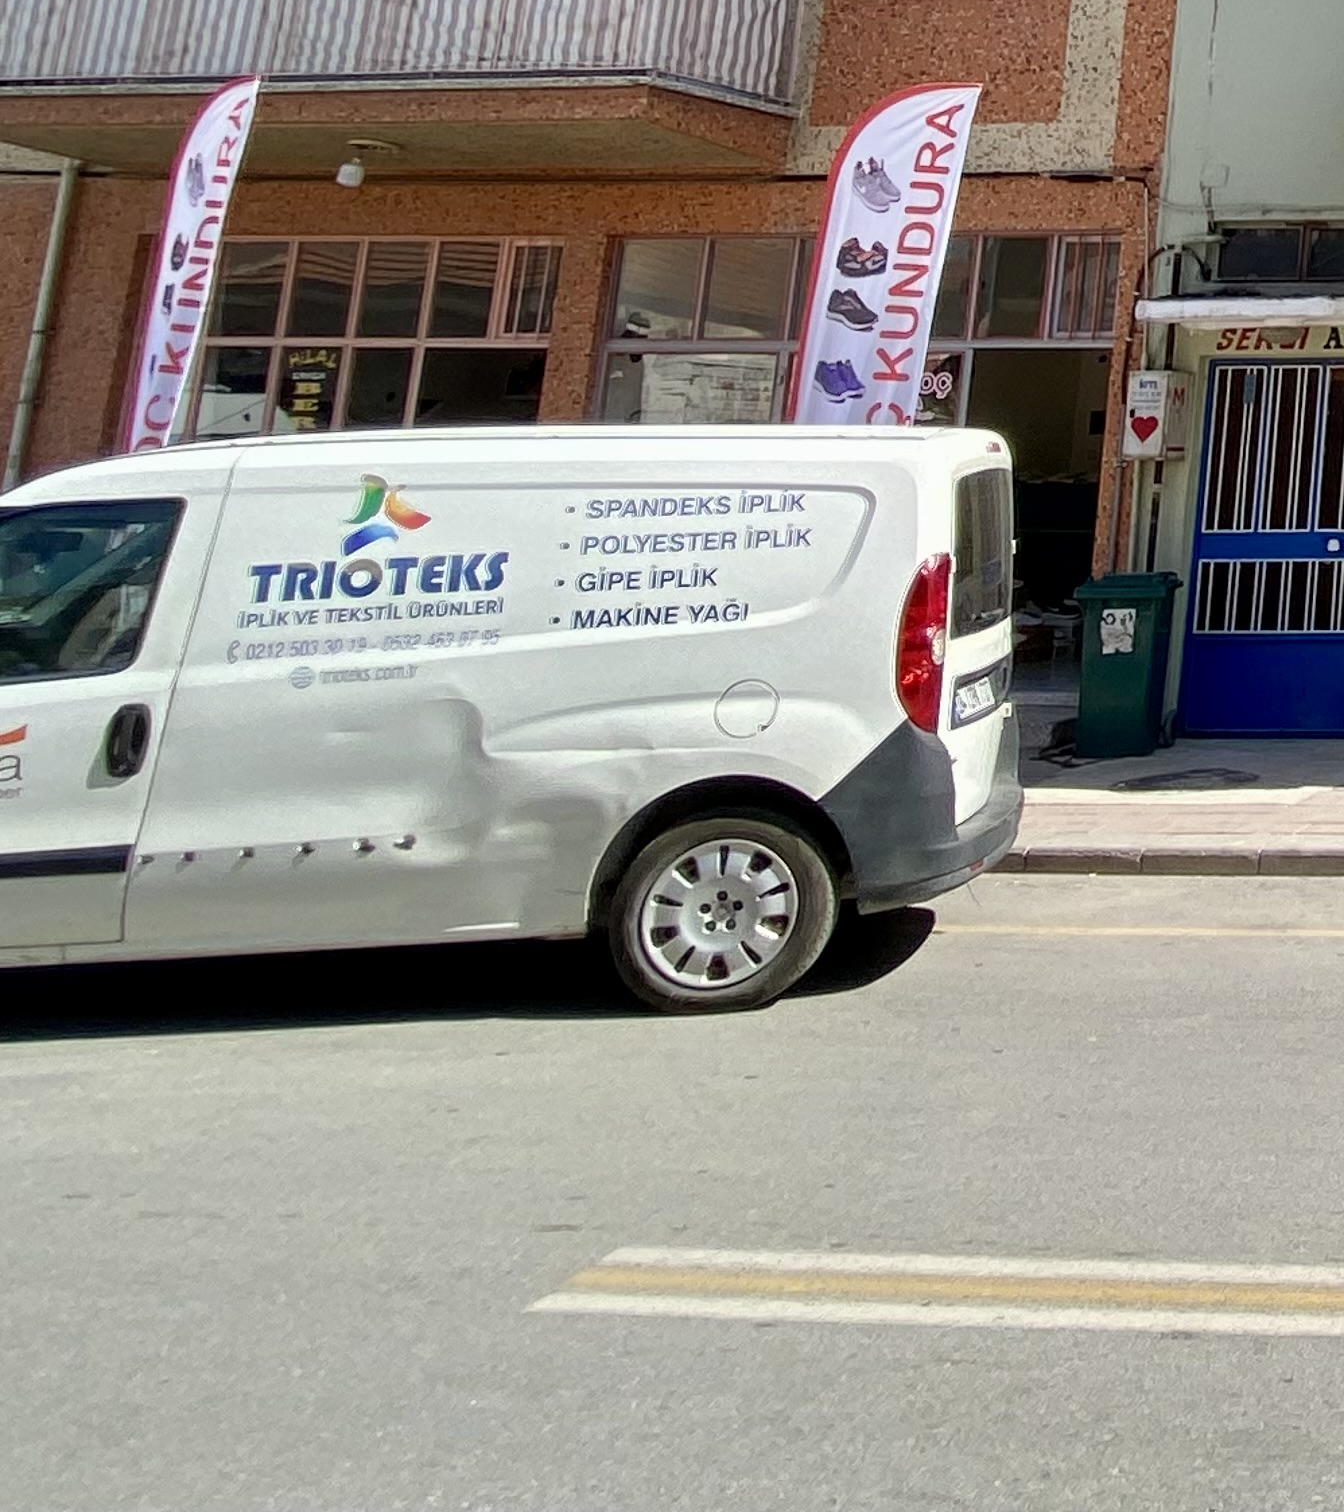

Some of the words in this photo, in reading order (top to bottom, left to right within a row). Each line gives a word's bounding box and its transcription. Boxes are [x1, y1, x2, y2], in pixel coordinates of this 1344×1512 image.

[873, 103, 965, 382] KUNDURA
[586, 496, 731, 519] SPANDEKS
[738, 489, 806, 514] İPLİK
[580, 532, 737, 555] POLYESTER
[744, 524, 812, 549] İPLİK
[248, 551, 510, 604] TRIOTEKS
[575, 566, 642, 592] GİPE
[649, 563, 718, 589] İPLİK
[237, 609, 289, 629] İPLİK
[295, 609, 319, 626] VE
[325, 603, 403, 624] TEKSTİL
[408, 597, 505, 619] ÜRÜNLERİ
[570, 602, 680, 629] MAKİNE
[686, 598, 749, 622] YAĞI
